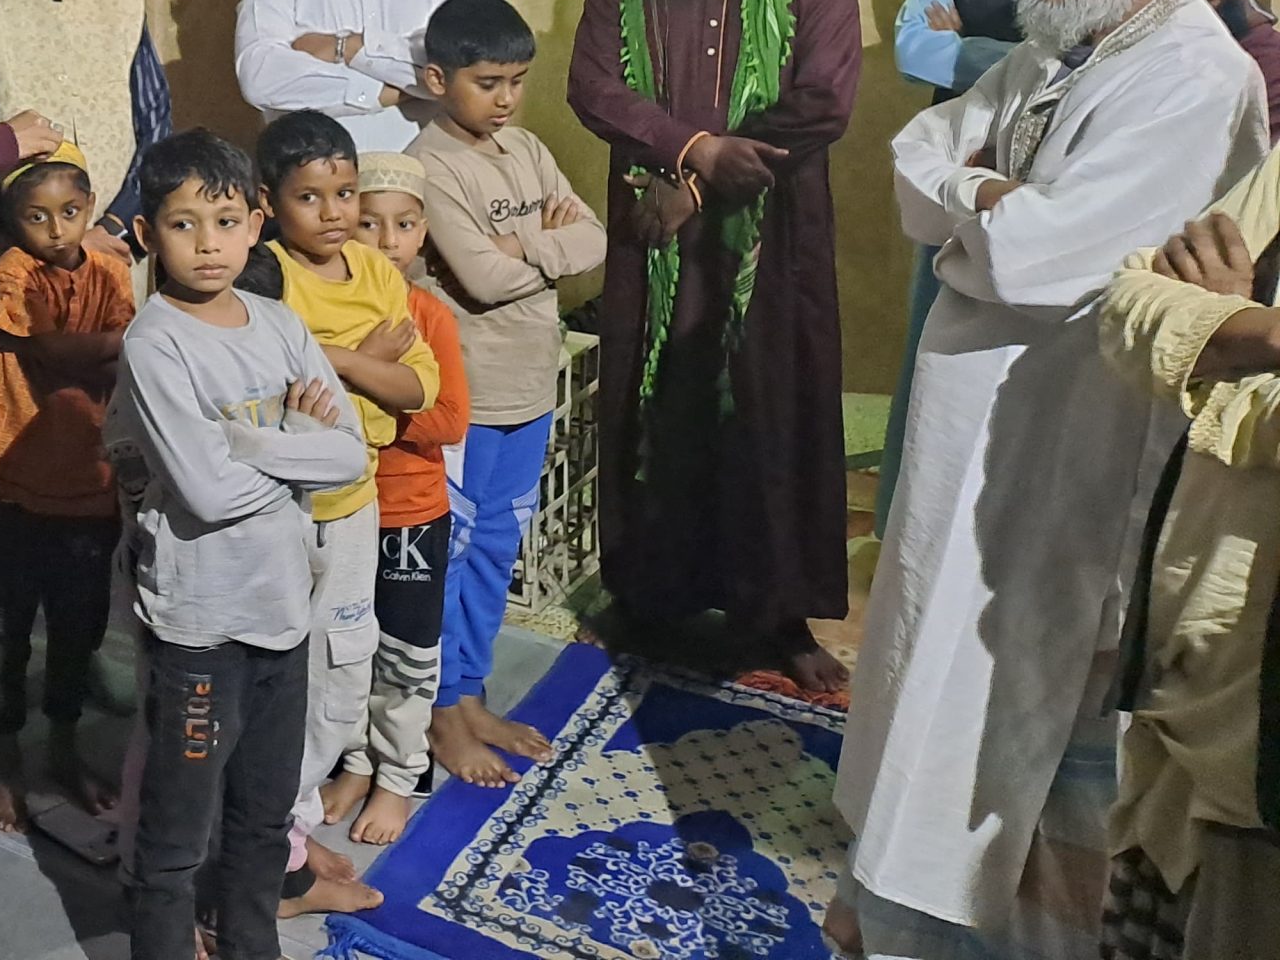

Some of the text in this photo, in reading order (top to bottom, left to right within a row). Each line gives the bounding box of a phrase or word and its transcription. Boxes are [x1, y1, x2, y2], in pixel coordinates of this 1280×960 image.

[382, 525, 432, 571] CK
[382, 569, 432, 582] Calvin Klein
